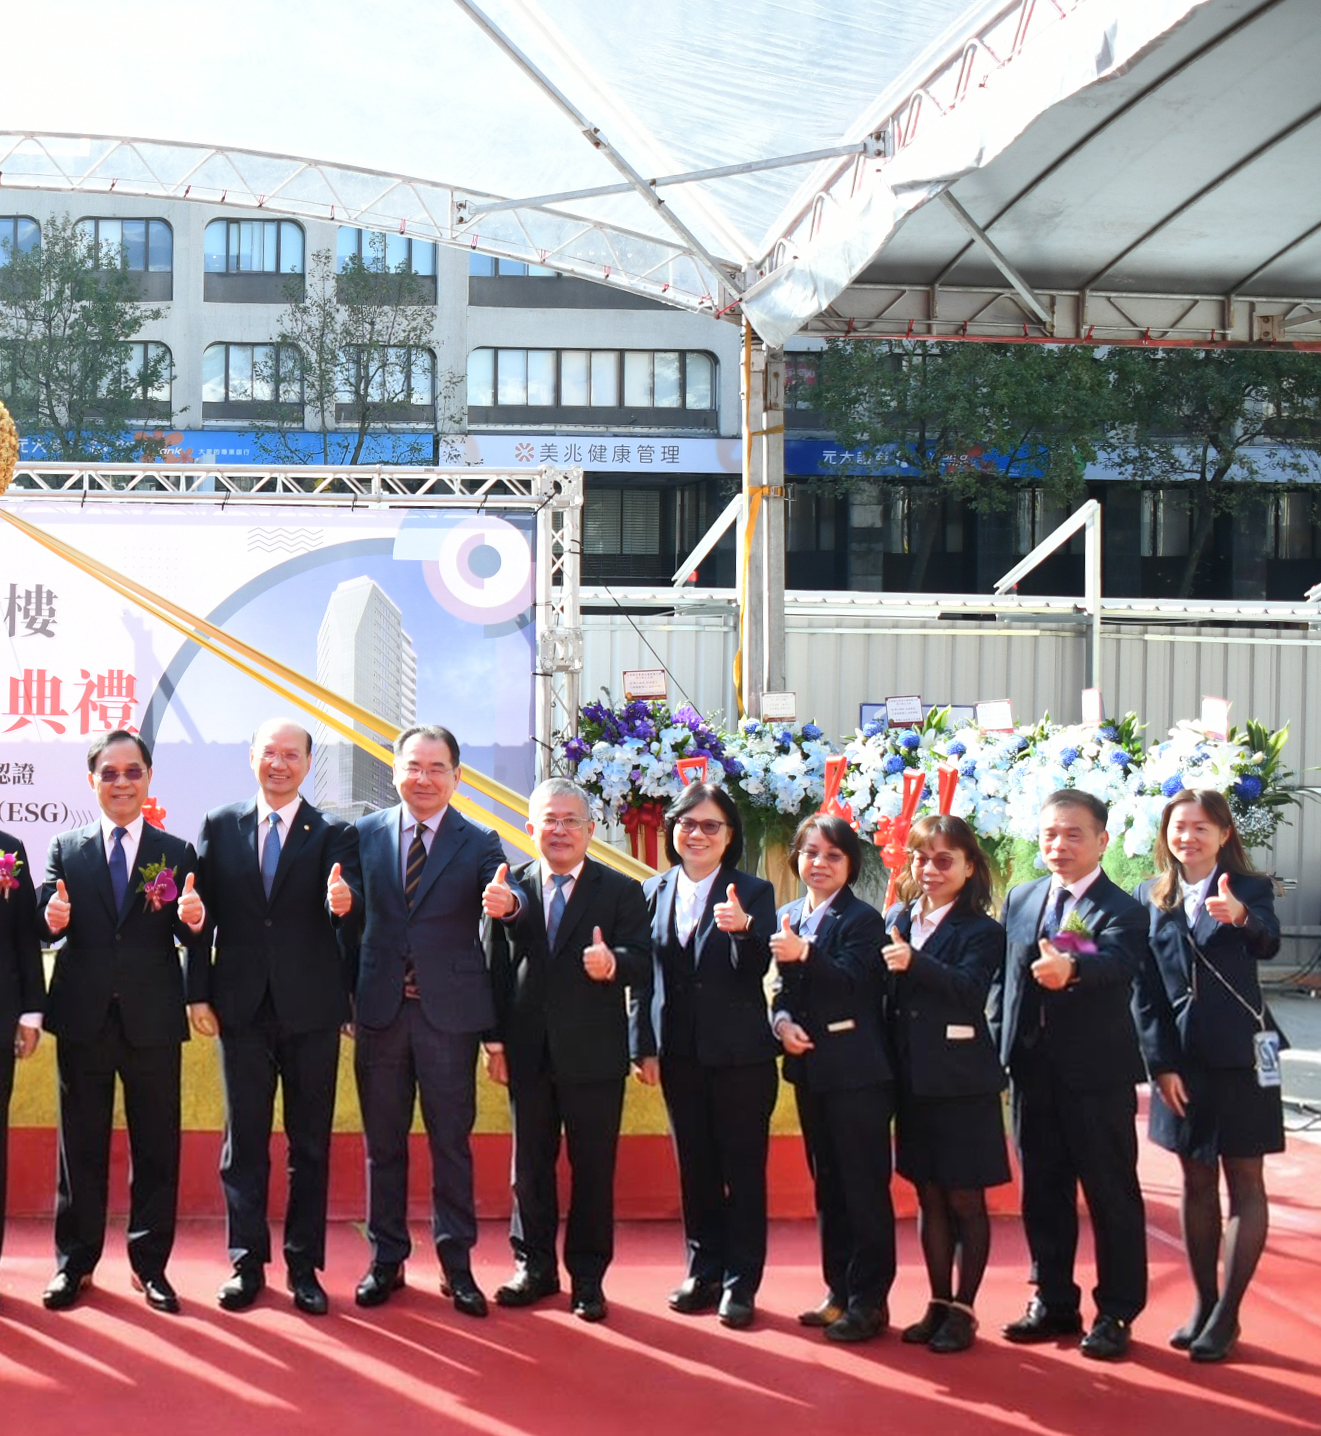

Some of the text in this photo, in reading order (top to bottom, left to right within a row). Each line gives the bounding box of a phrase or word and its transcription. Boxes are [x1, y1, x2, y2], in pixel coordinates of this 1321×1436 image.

[539, 443, 681, 464] 美兆健康管理
